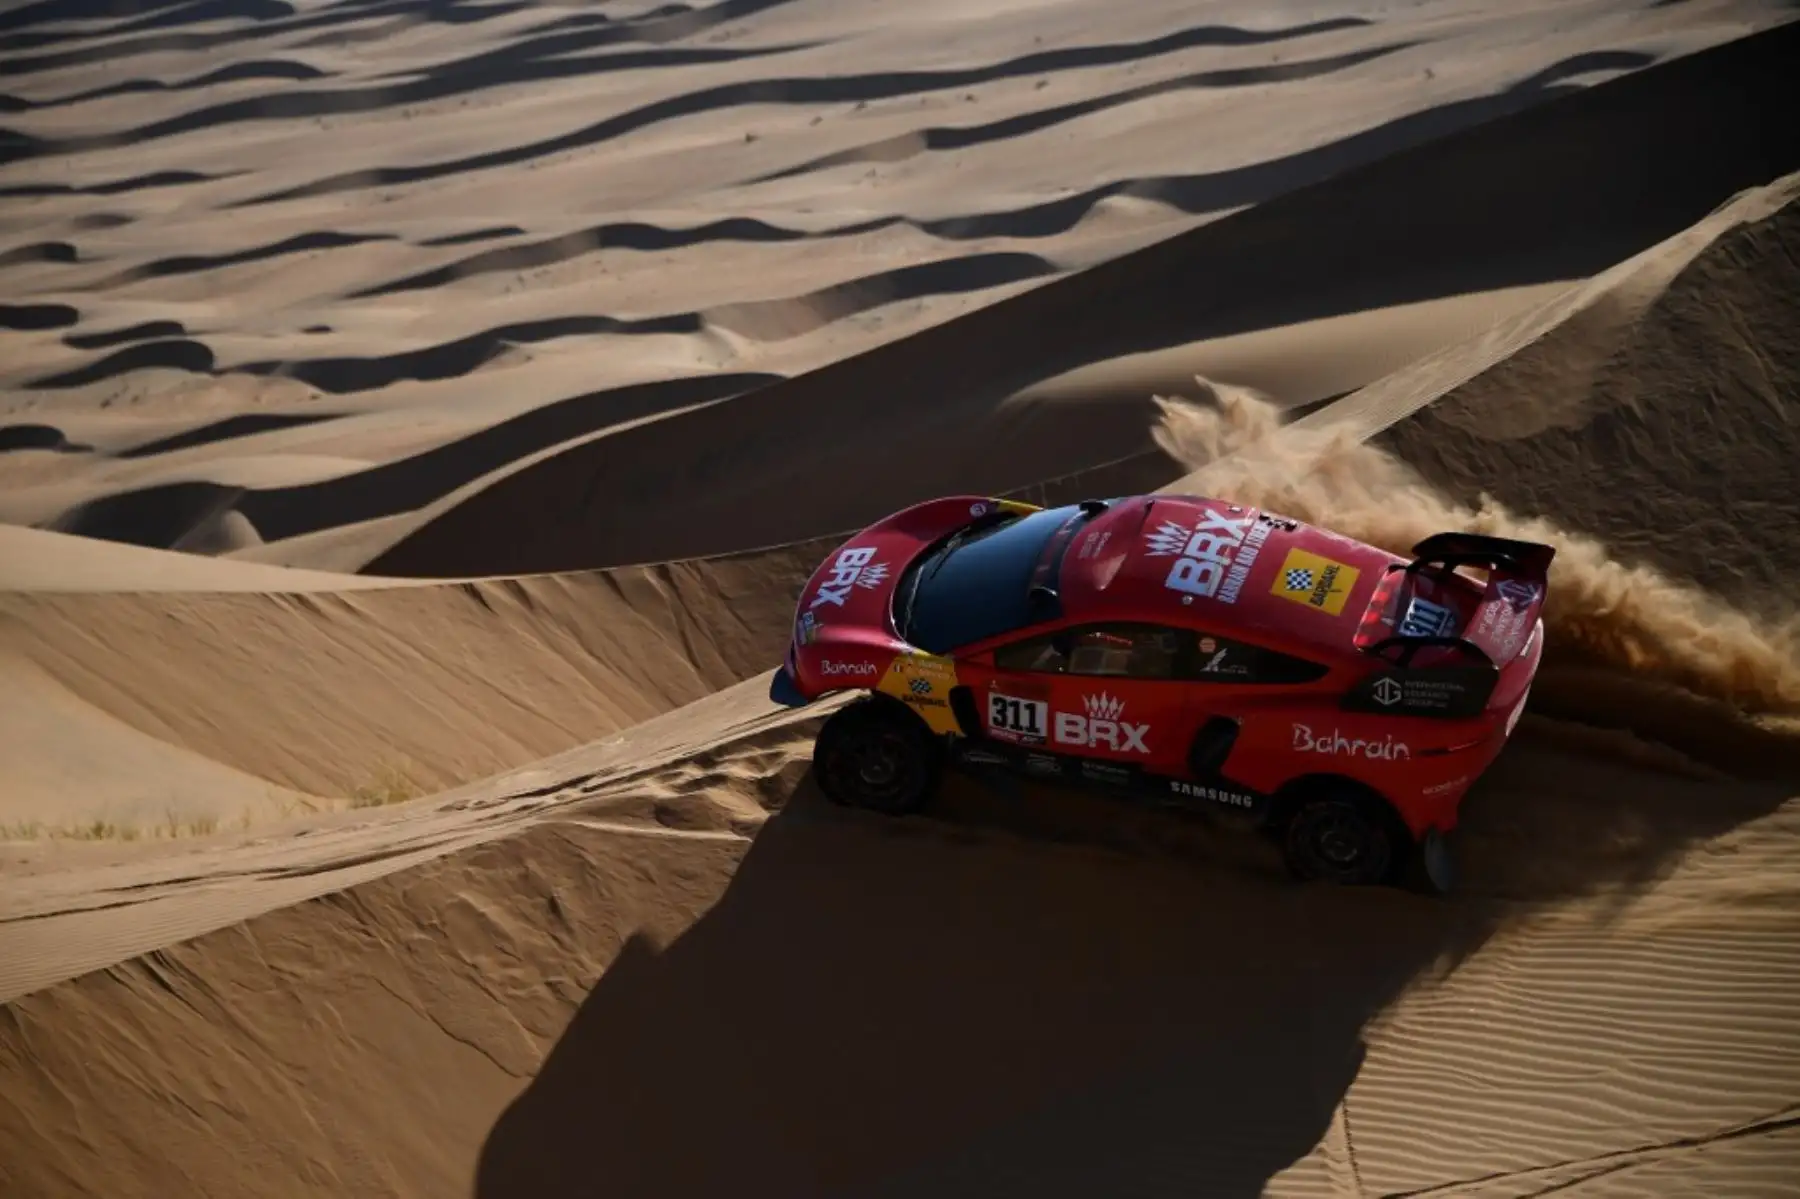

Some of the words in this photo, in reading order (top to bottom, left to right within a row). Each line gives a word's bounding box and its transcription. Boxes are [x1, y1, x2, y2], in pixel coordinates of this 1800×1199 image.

[1165, 508, 1254, 598] BRX
[810, 547, 878, 608] BRX
[820, 659, 877, 676] Bahrain
[991, 696, 1040, 733] 311
[1054, 710, 1152, 754] BRX
[1292, 723, 1413, 761] Bahrain
[1170, 780, 1254, 808] SAMSUNG
